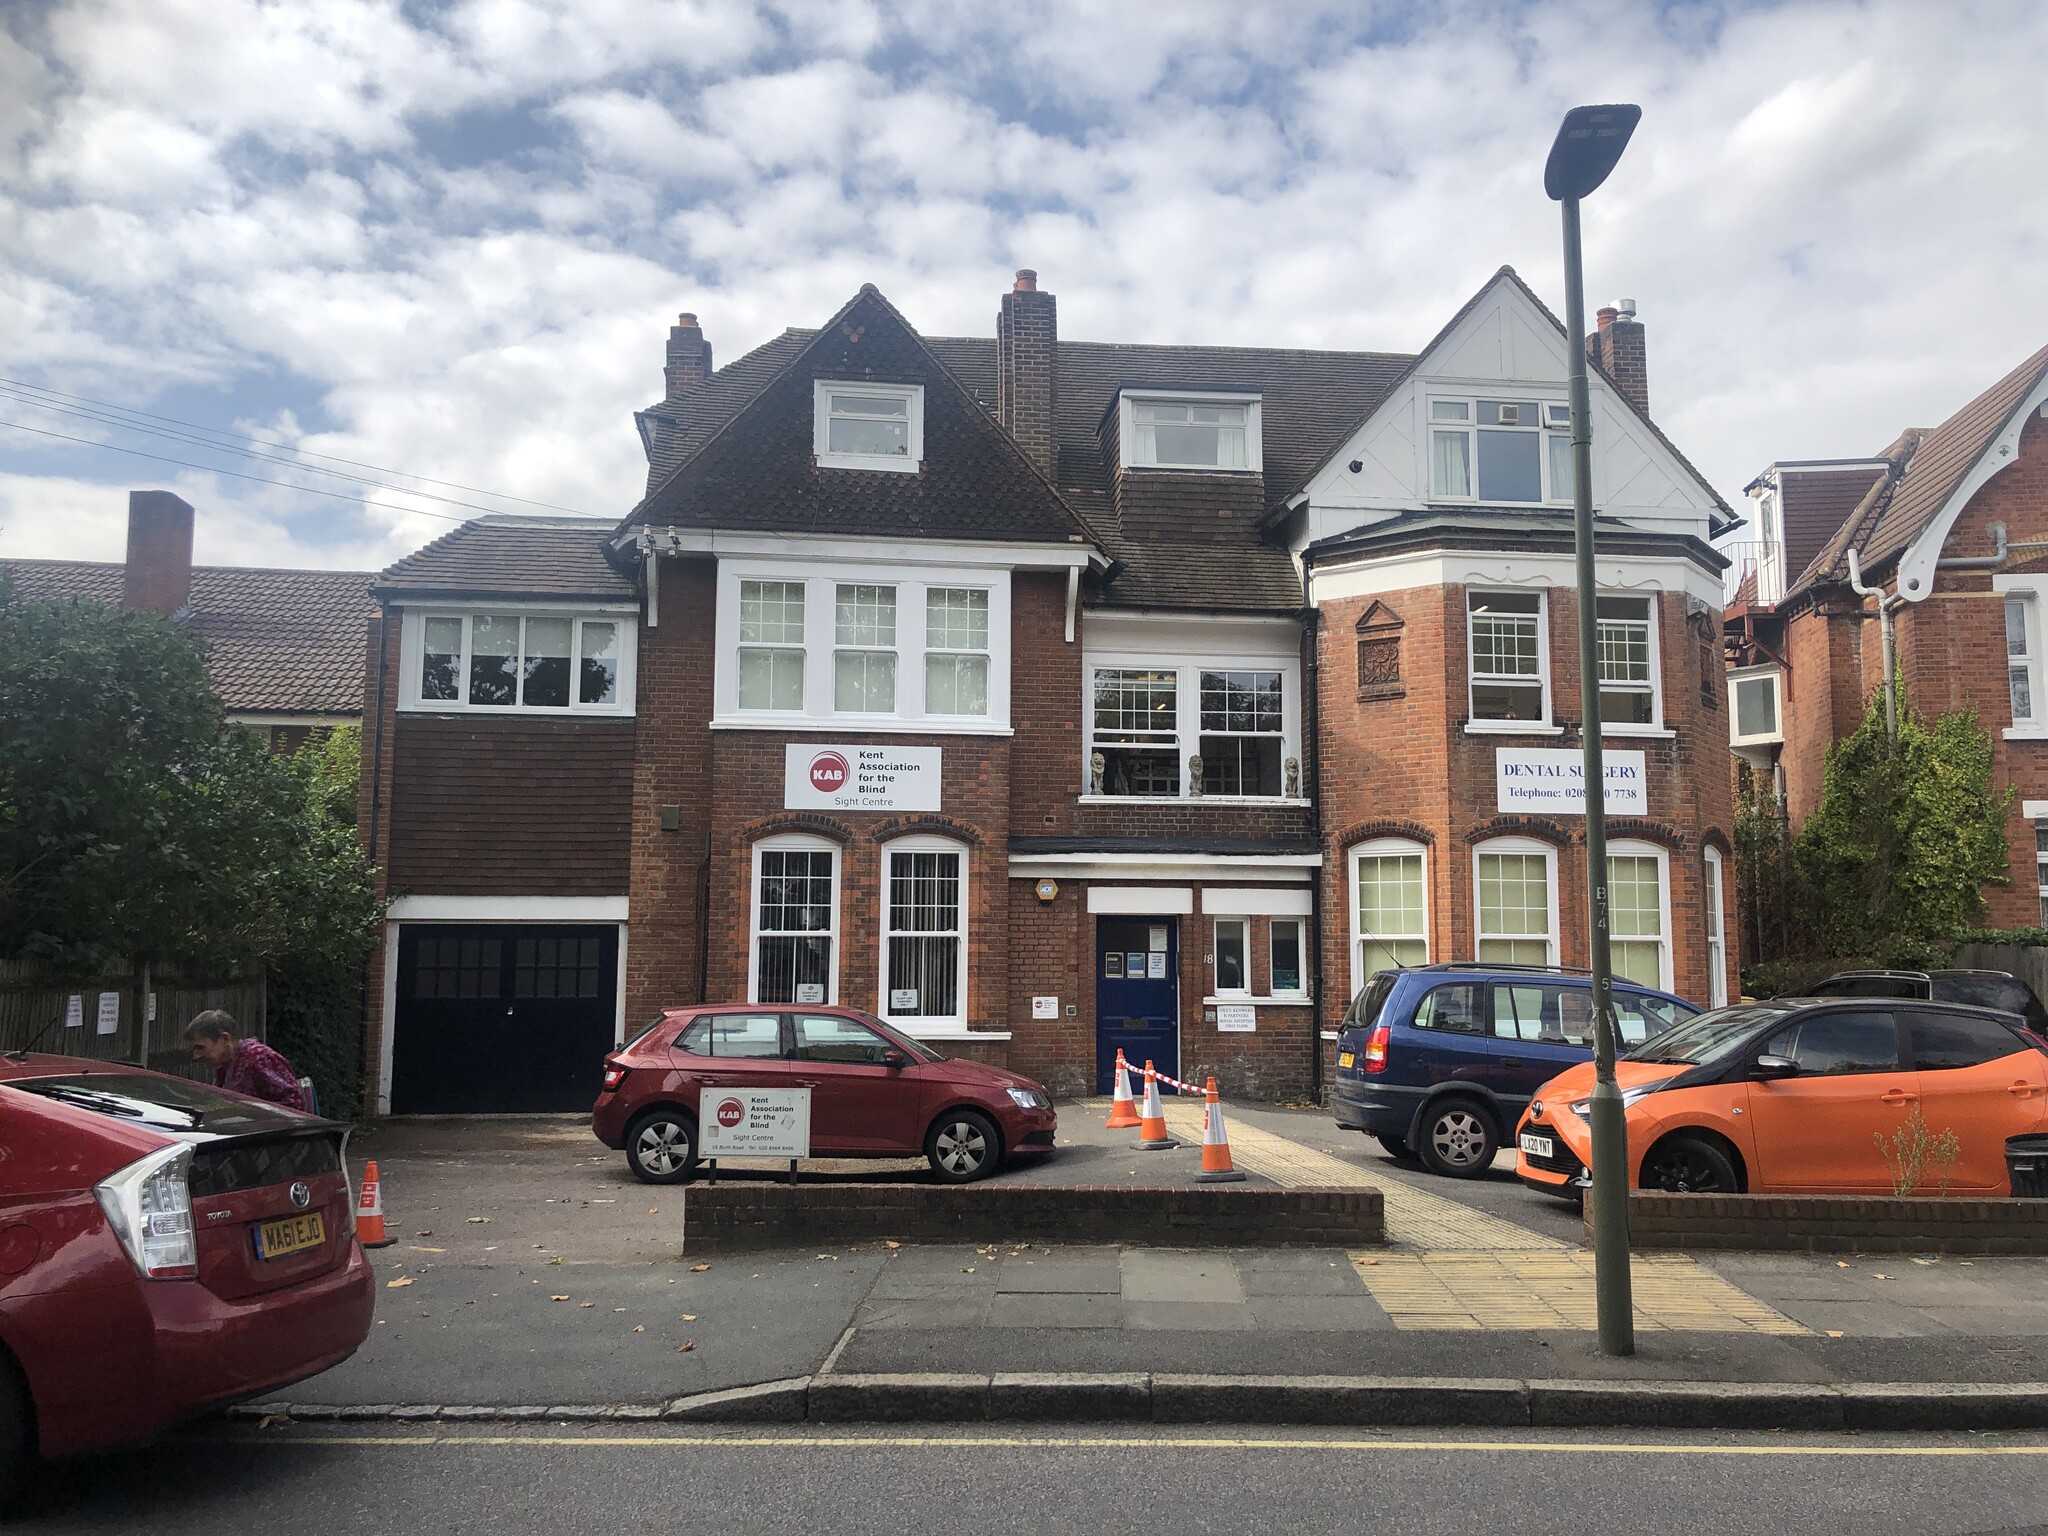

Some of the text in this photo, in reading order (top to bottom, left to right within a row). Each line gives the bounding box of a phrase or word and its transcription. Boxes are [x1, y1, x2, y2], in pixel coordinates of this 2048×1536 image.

[859, 751, 884, 760] Kent
[858, 762, 921, 772] Association
[1504, 764, 1639, 778] DENTAL SUGERY
[813, 769, 843, 781] KAB
[858, 773, 895, 783] for the
[858, 785, 886, 794] Blind
[1508, 787, 1561, 800] Telephone:
[1614, 789, 1637, 799] 7738
[834, 797, 894, 807] Sight Centre
[1203, 953, 1214, 964] 18
[1601, 977, 1609, 990] 5
[719, 1110, 740, 1119] KAB
[1523, 1135, 1550, 1154] LX20 YNT
[207, 1210, 232, 1220] TOYOTA
[266, 1222, 296, 1252] MA61
